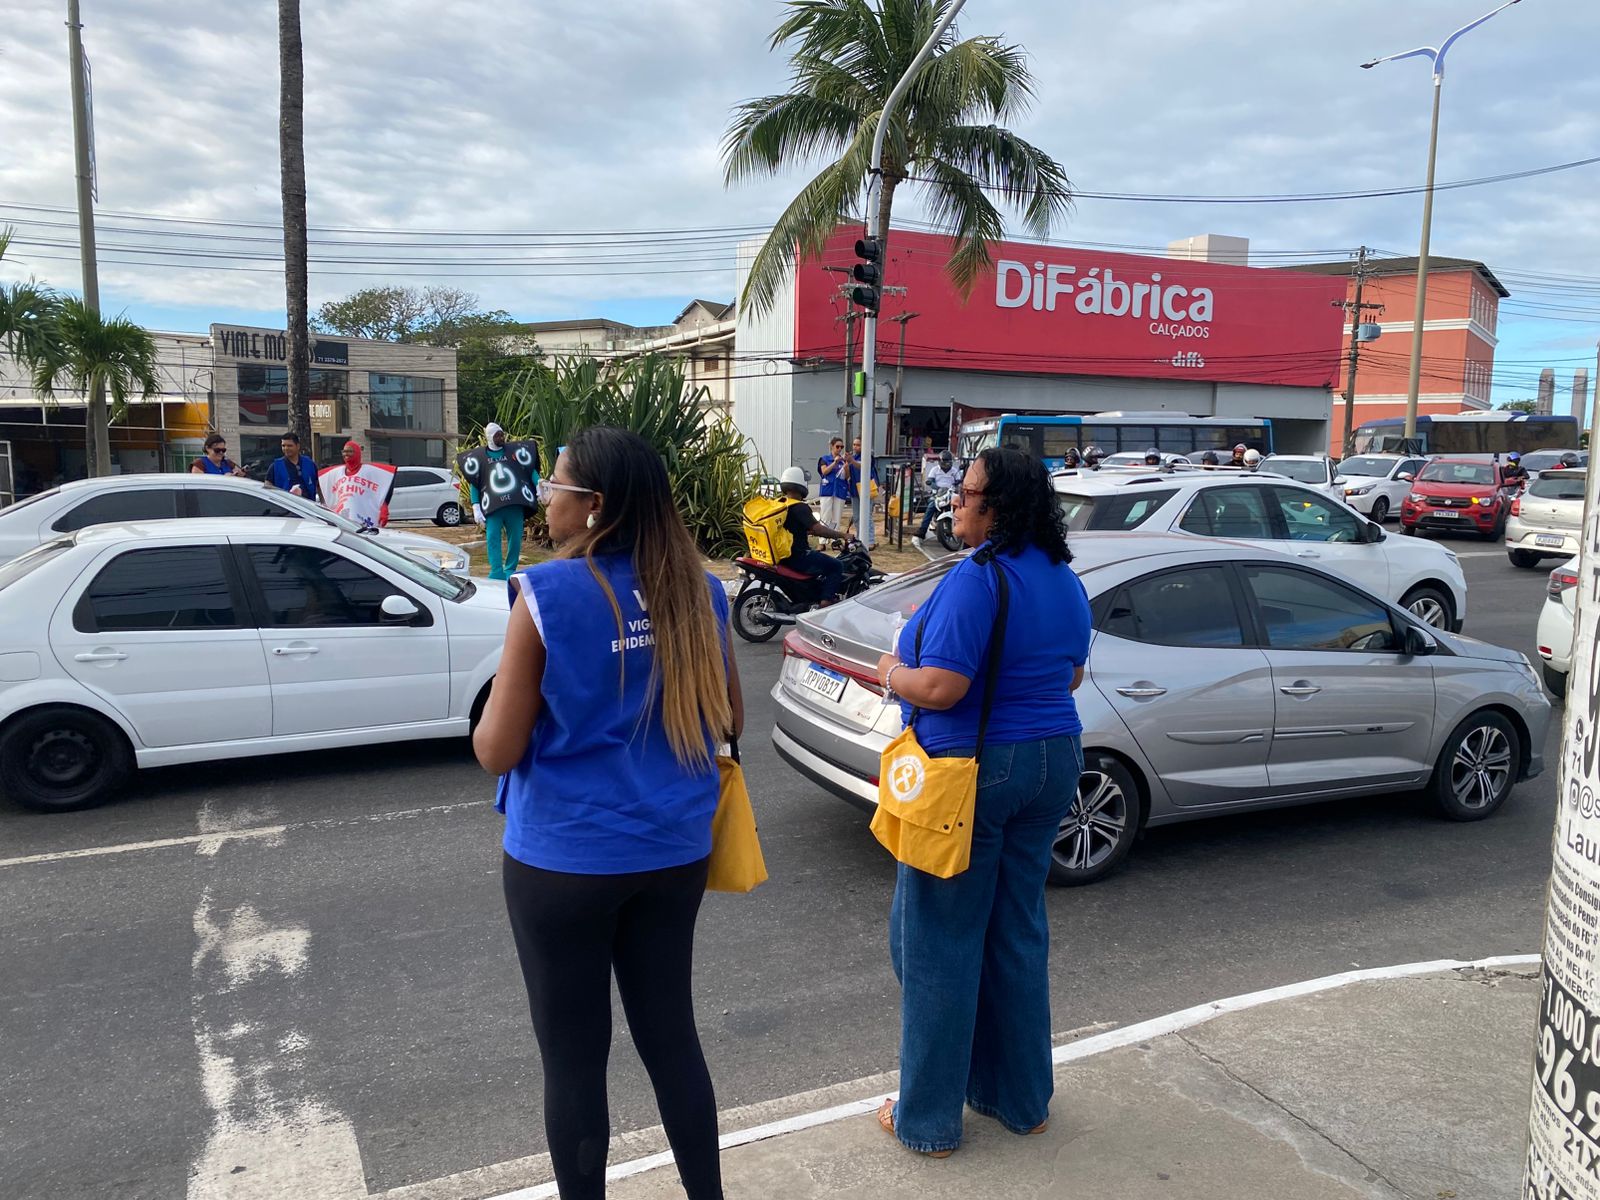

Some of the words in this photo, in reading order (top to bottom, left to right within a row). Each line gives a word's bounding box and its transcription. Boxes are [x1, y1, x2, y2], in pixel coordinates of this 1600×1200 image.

[995, 259, 1214, 322] DiFábrica
[1149, 322, 1209, 339] CALÇADOS
[346, 485, 364, 495] HIV
[628, 618, 651, 633] VIG
[611, 633, 656, 653] EPIDEM
[1567, 819, 1600, 867] Lau
[1575, 881, 1600, 912] Consig
[1572, 922, 1580, 938] do
[1555, 964, 1564, 980] DO
[1565, 974, 1589, 1002] MERC
[1547, 977, 1600, 1067] 1.000,0
[1541, 1024, 1600, 1141] 96,9
